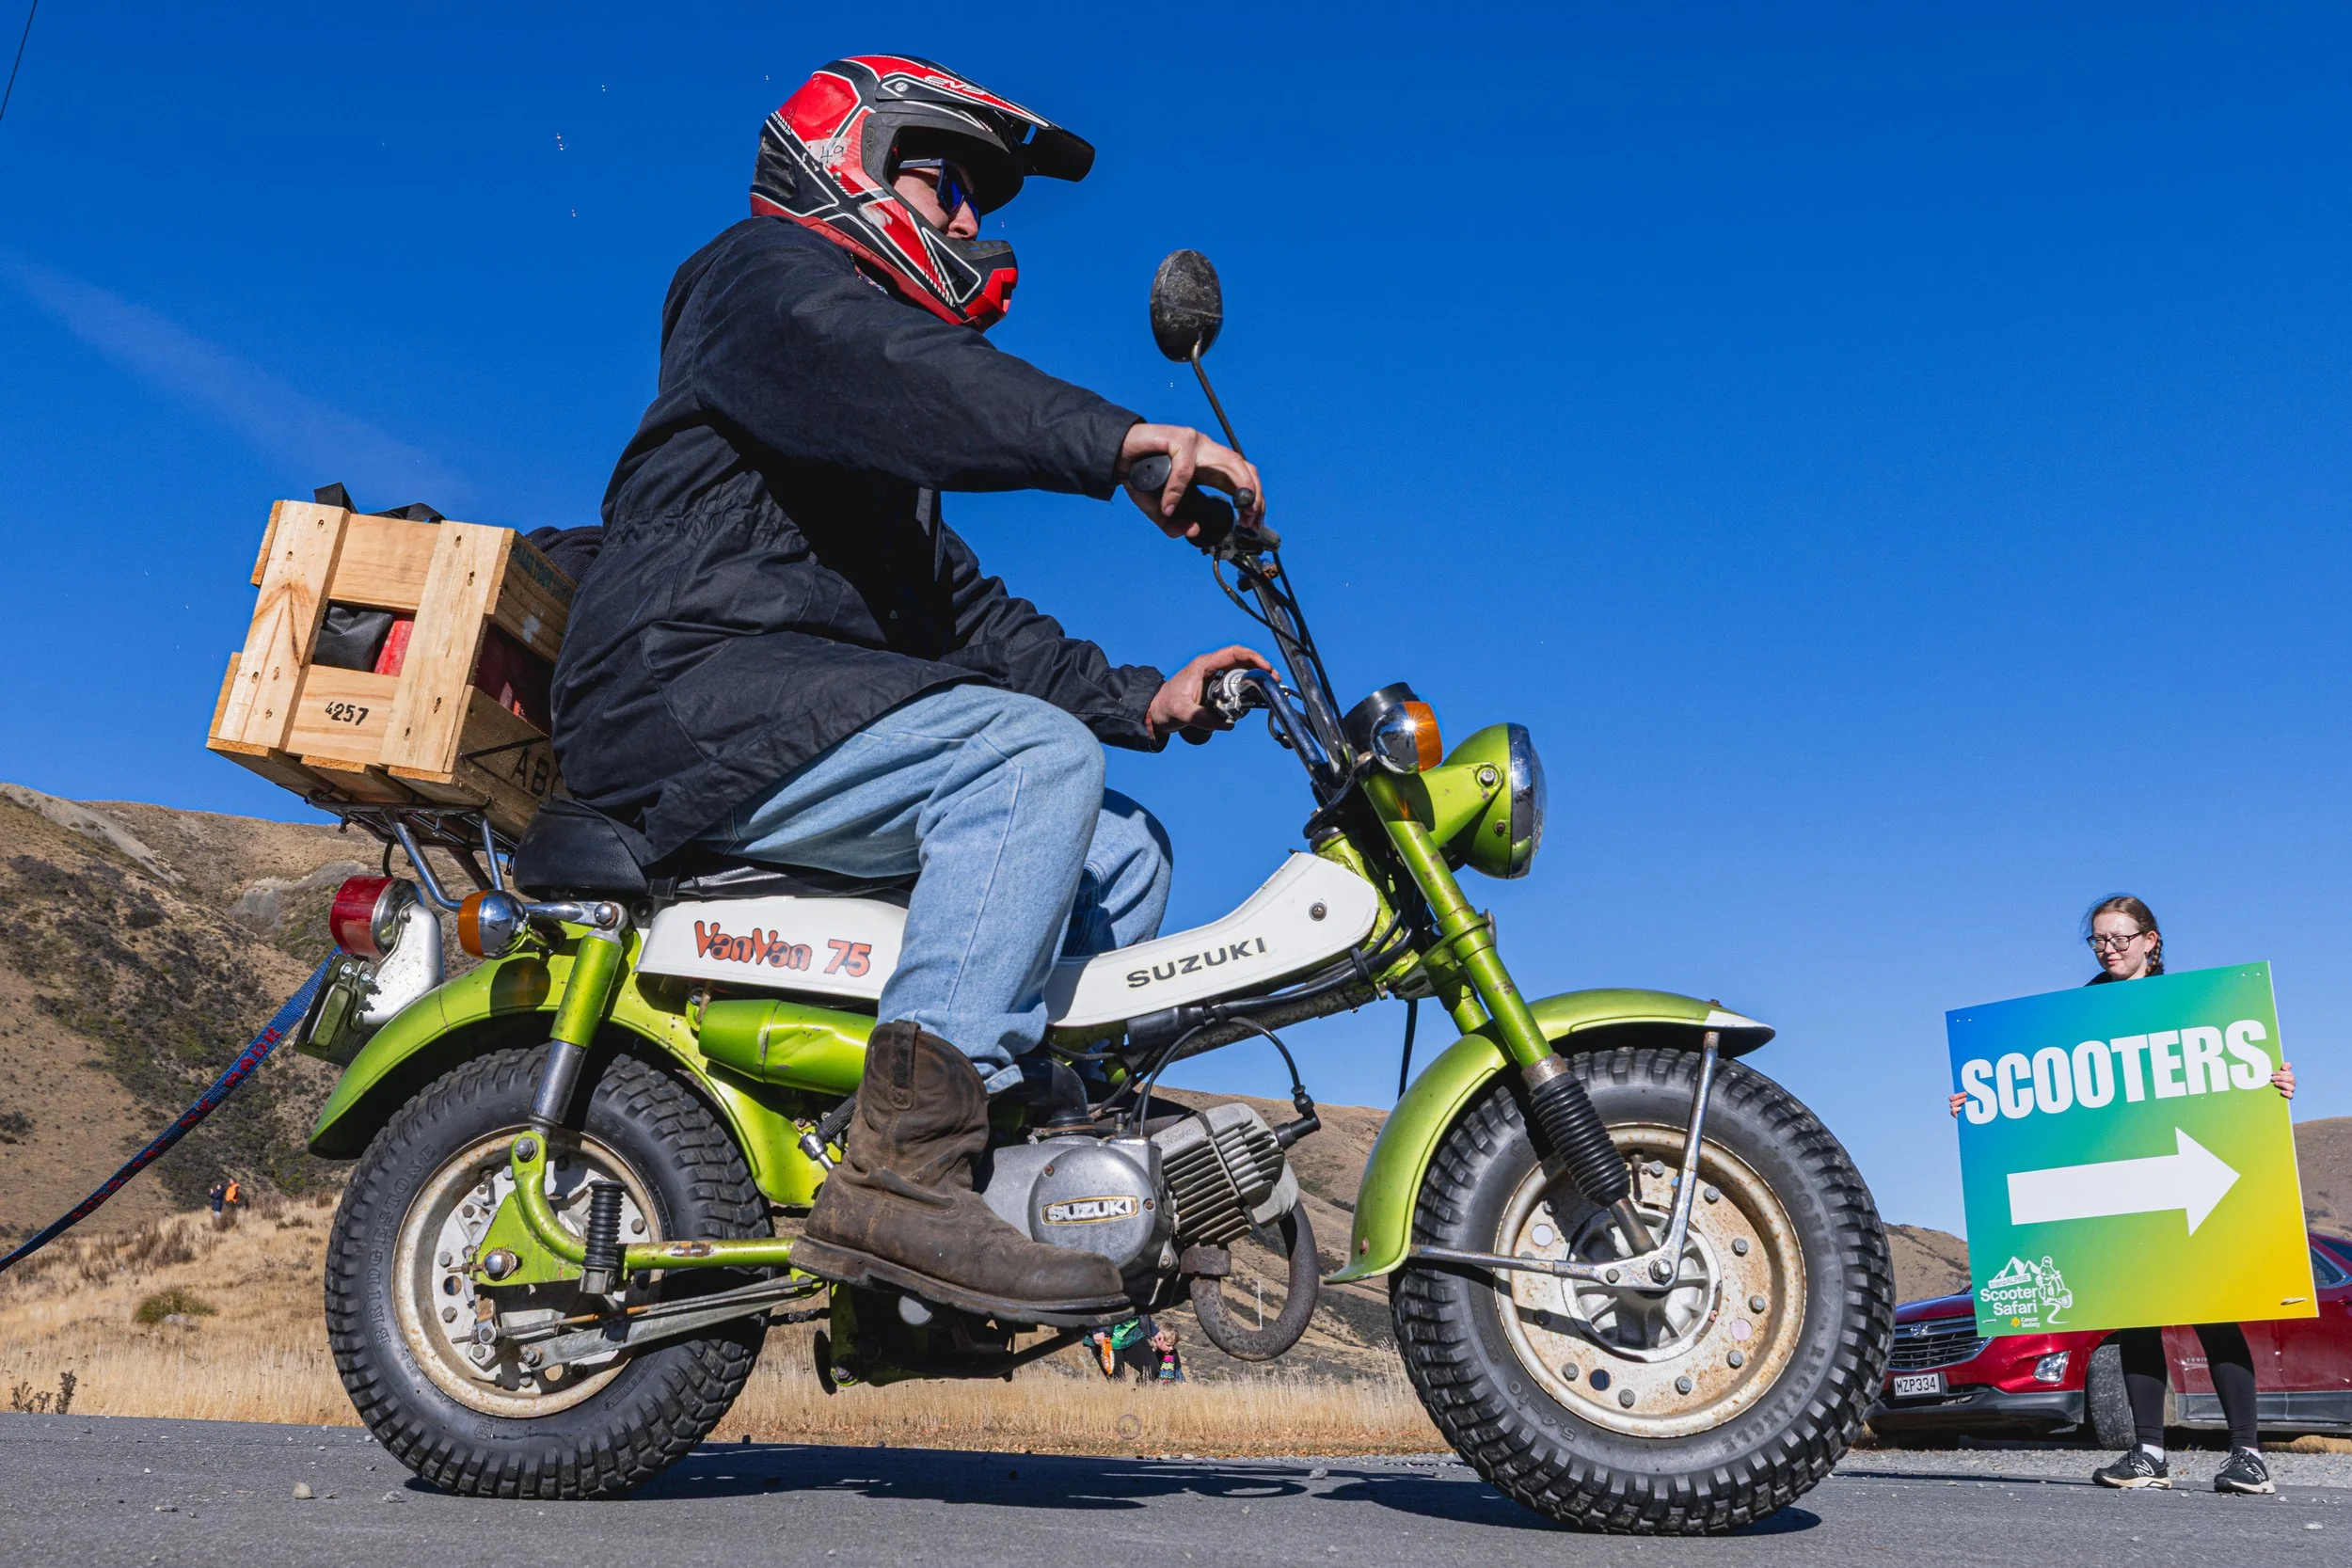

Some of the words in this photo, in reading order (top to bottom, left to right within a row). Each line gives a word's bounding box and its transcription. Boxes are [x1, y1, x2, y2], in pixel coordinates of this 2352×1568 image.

[325, 701, 370, 726] 4257
[693, 920, 813, 972] VanVan
[823, 938, 872, 978] 75
[1126, 937, 1266, 989] SUZUKI
[1960, 1019, 2273, 1125] SCOOTERS
[1046, 1198, 1133, 1222] SUZUKI
[367, 1143, 437, 1346] BRIDGESTONE
[1979, 1286, 2038, 1302] Scooter
[1993, 1300, 2038, 1316] Safari
[1896, 1376, 1936, 1393] MZP334
[1508, 1380, 1578, 1442] 5.4-10
